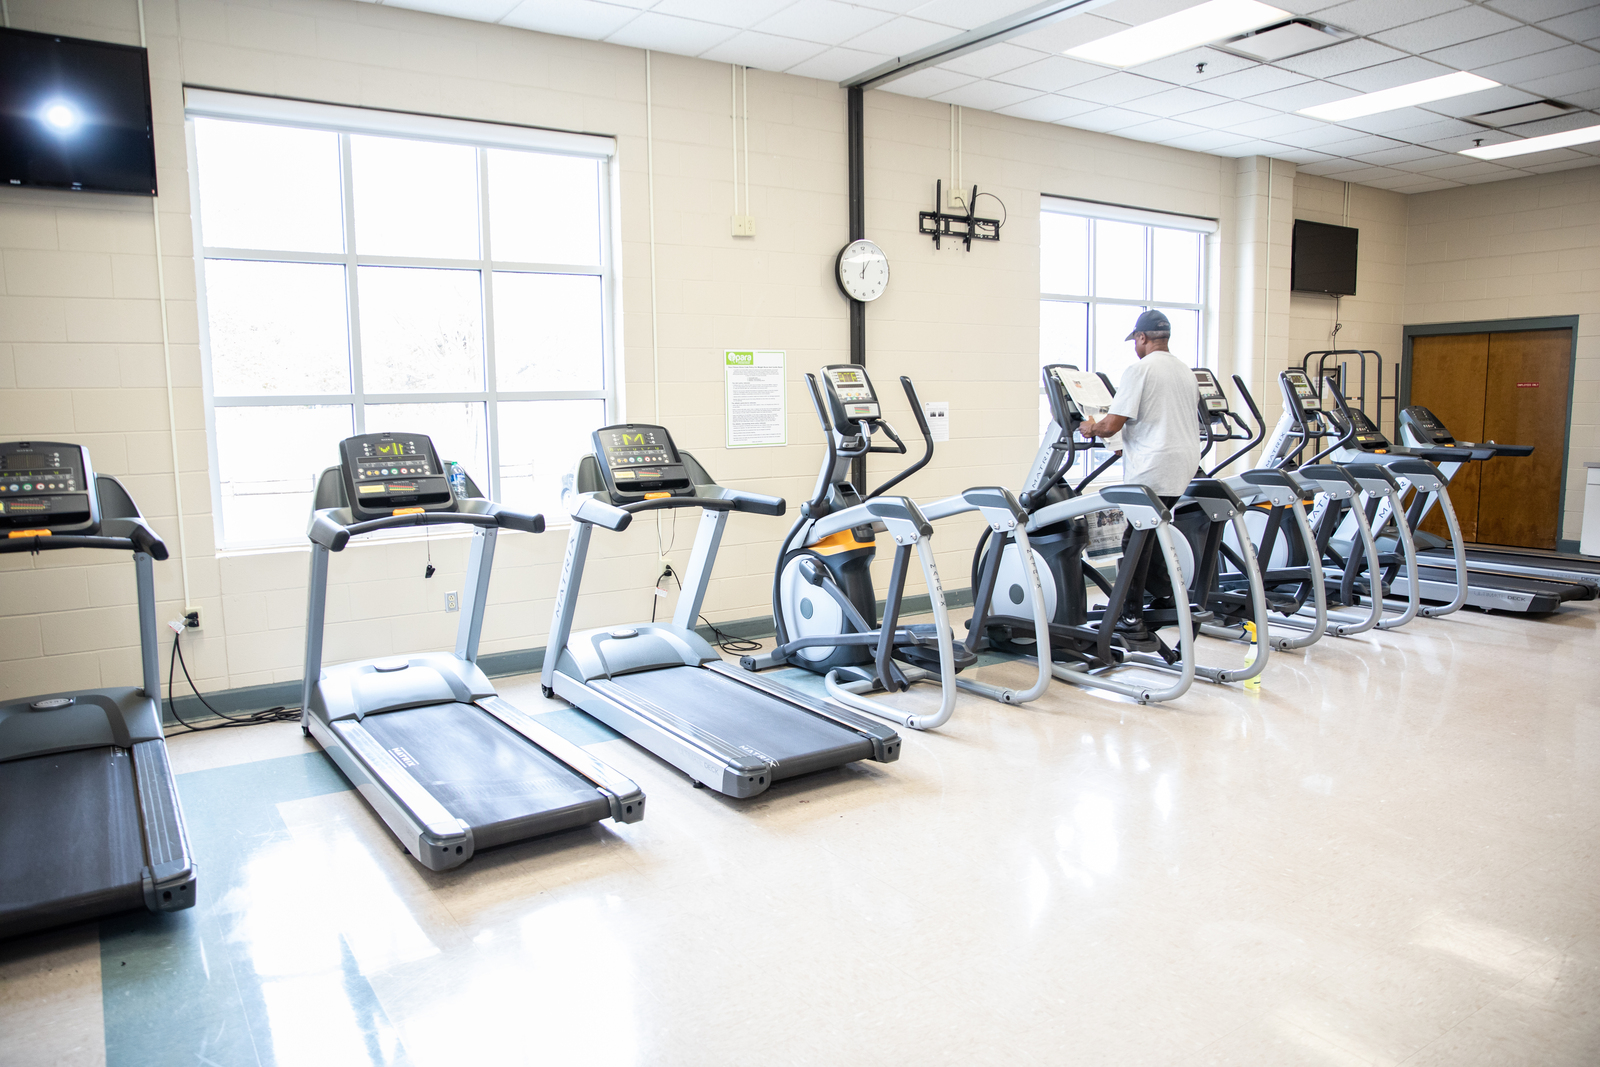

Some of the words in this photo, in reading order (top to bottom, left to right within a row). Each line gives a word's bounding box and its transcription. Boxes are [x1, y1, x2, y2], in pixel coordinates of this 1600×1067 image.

[735, 354, 752, 363] para
[1032, 444, 1052, 489] MATRIX
[1266, 432, 1285, 467] MATRIX
[555, 537, 575, 618] MATRIX
[929, 563, 946, 606] MATRIX
[1027, 549, 1041, 589] MATRIX
[1170, 546, 1185, 586] MATRIX
[391, 747, 416, 767] MATRIX
[703, 761, 720, 776] DECK
[738, 745, 778, 768] MATRIX
